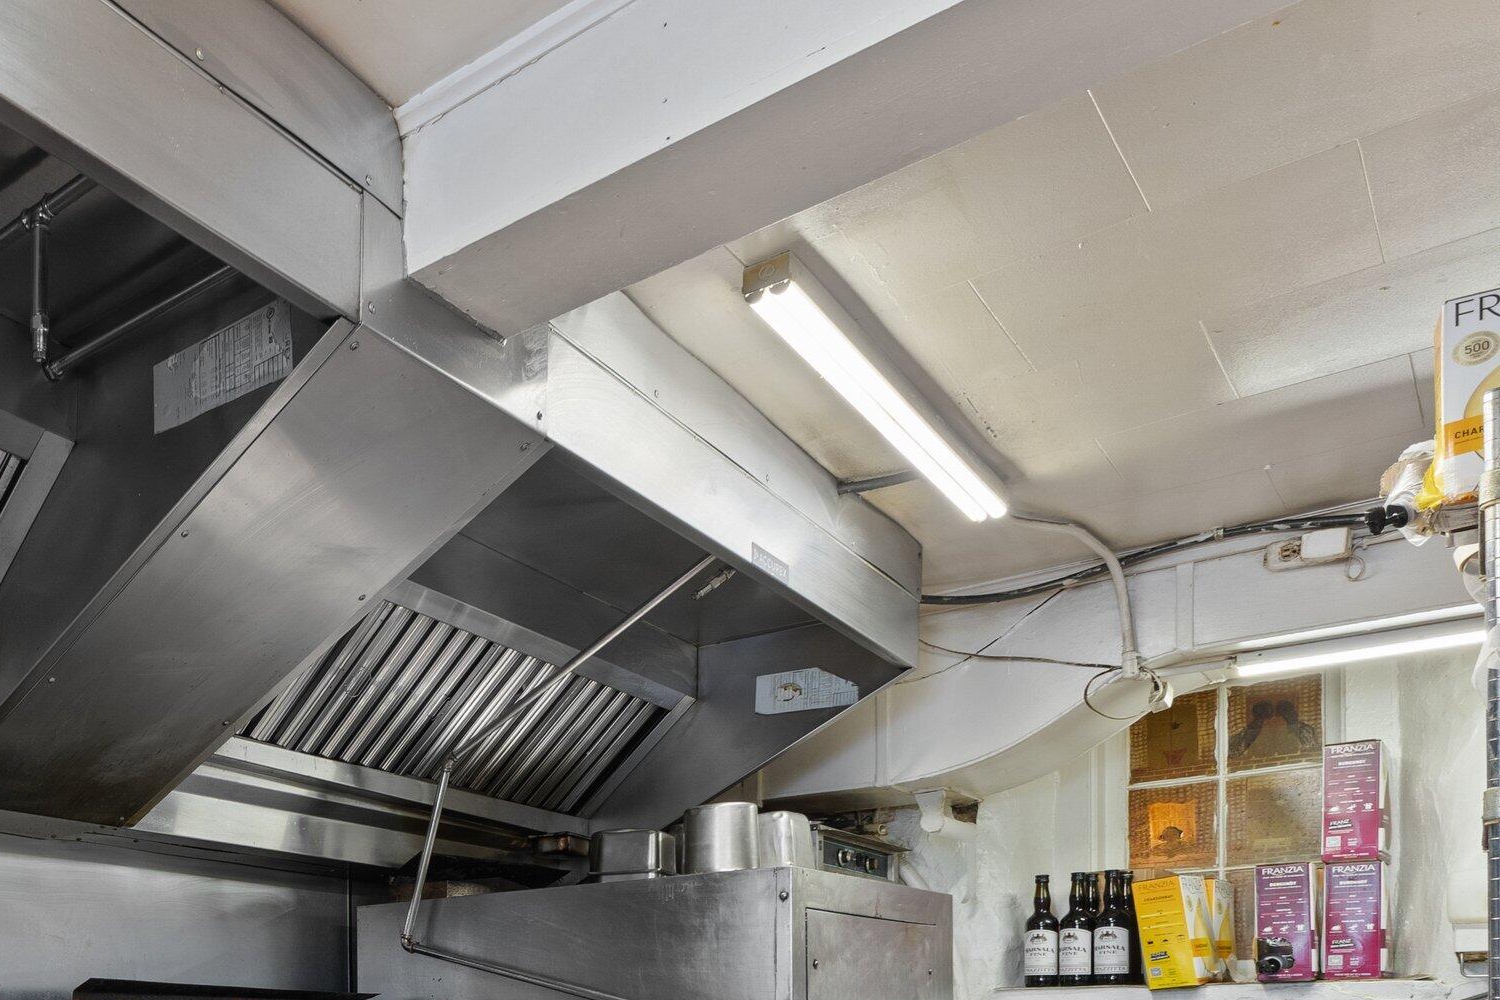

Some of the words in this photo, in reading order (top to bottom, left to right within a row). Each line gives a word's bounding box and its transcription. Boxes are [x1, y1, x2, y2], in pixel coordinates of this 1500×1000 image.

[1464, 340, 1490, 355] 500
[1330, 743, 1375, 755] FRANZIA
[1261, 865, 1304, 876] FRANZIA
[1332, 863, 1376, 874] FRANZIA
[1138, 879, 1176, 891] FRANZIA
